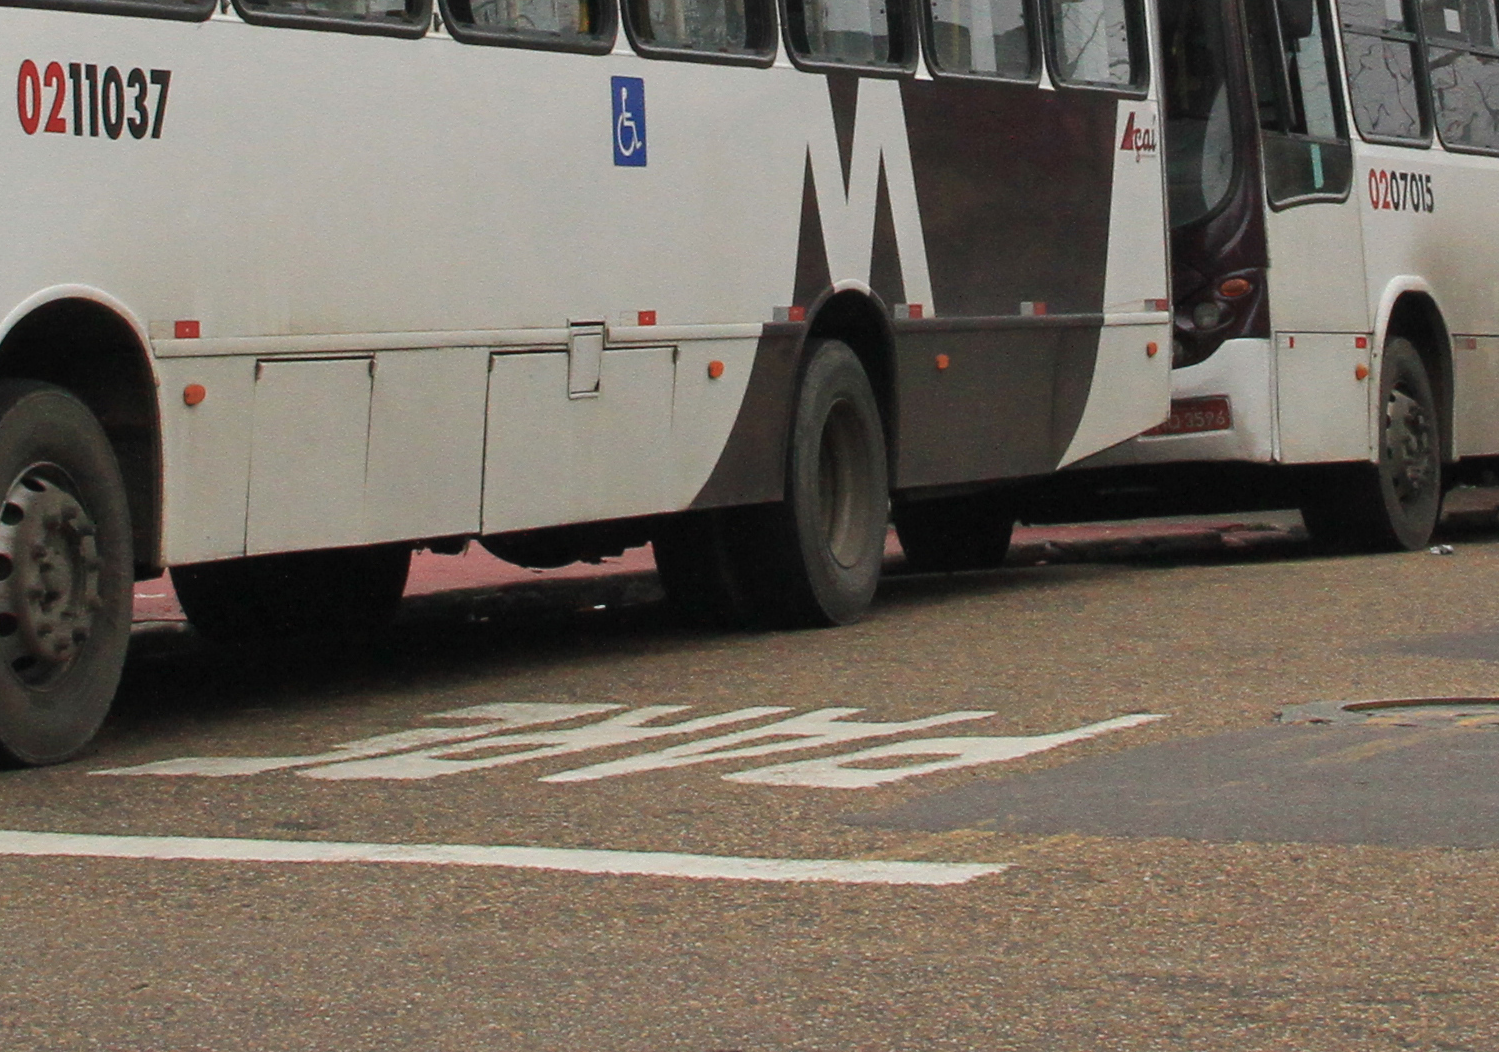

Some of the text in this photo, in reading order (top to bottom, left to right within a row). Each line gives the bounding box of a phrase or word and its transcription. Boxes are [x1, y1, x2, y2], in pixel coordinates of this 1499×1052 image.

[17, 59, 172, 140] 0211037
[1369, 168, 1435, 213] 0207015
[86, 700, 1165, 789] PARE
